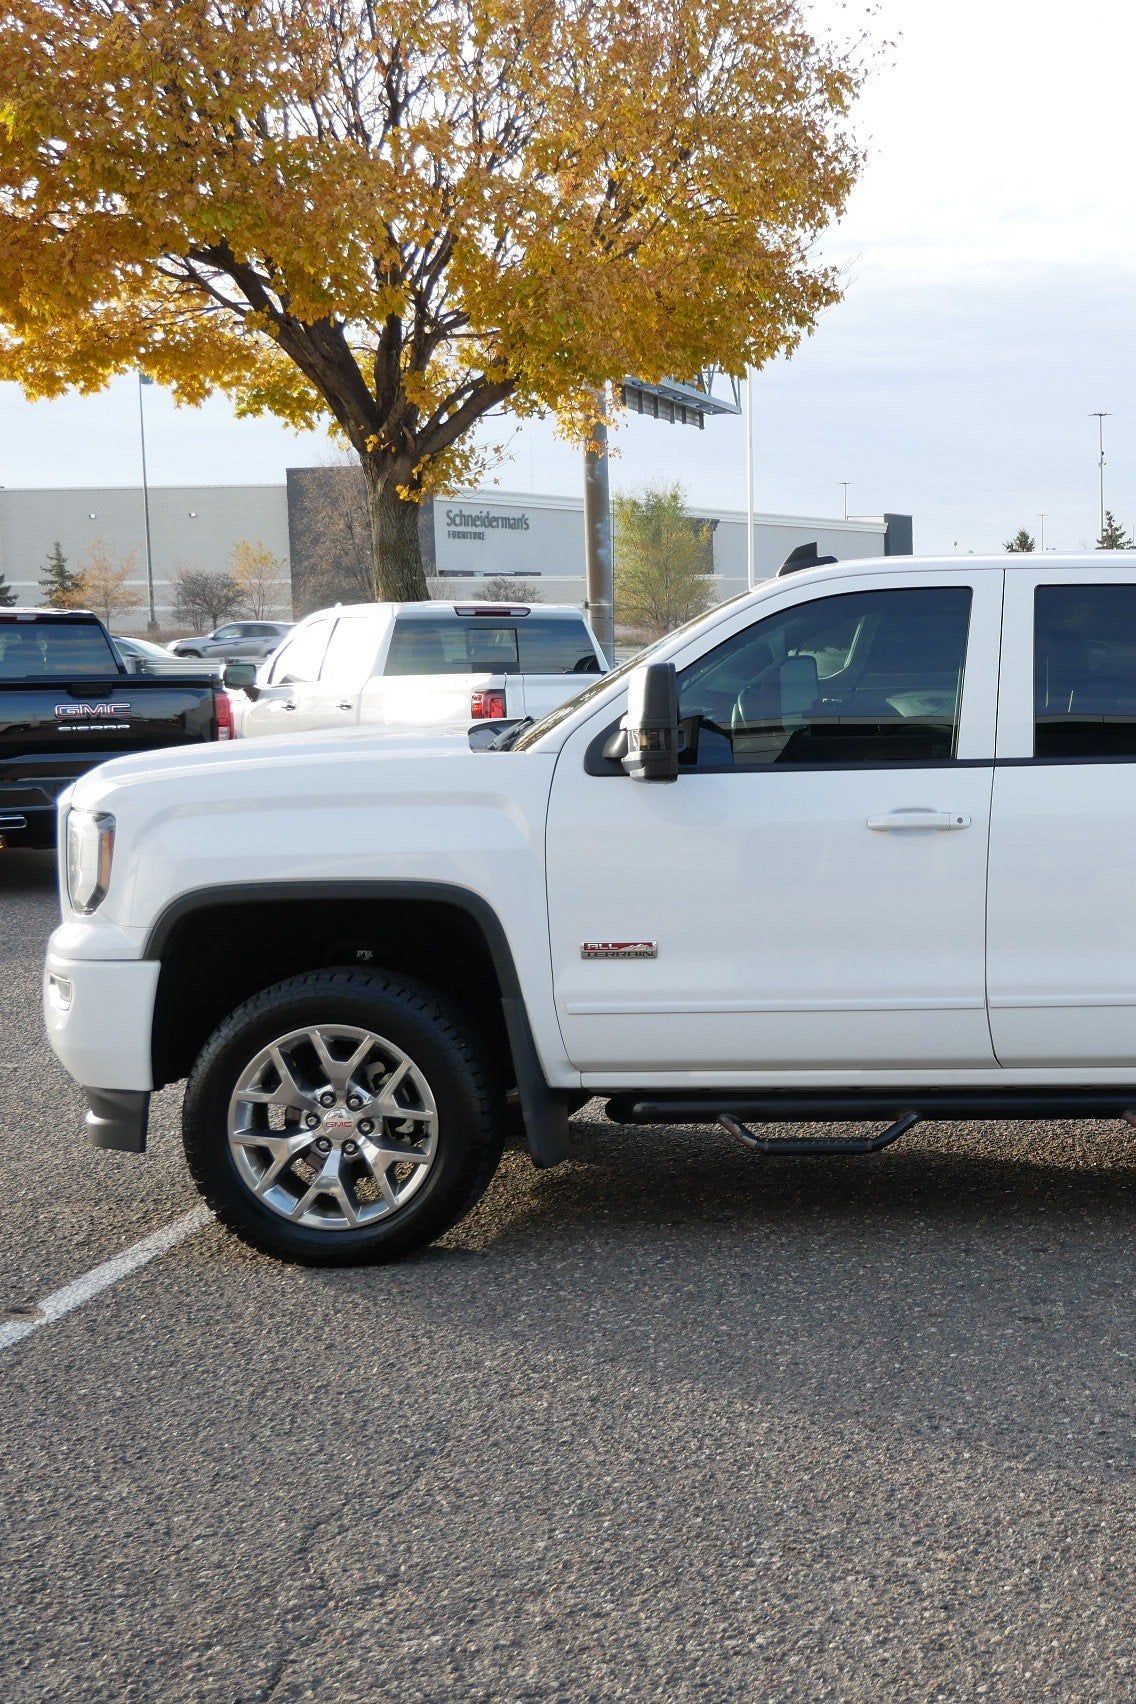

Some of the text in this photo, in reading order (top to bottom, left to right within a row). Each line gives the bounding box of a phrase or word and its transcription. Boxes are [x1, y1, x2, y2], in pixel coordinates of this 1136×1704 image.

[446, 509, 530, 531] Schneiderman's
[447, 530, 486, 541] FURNITURE
[55, 702, 131, 718] GMC
